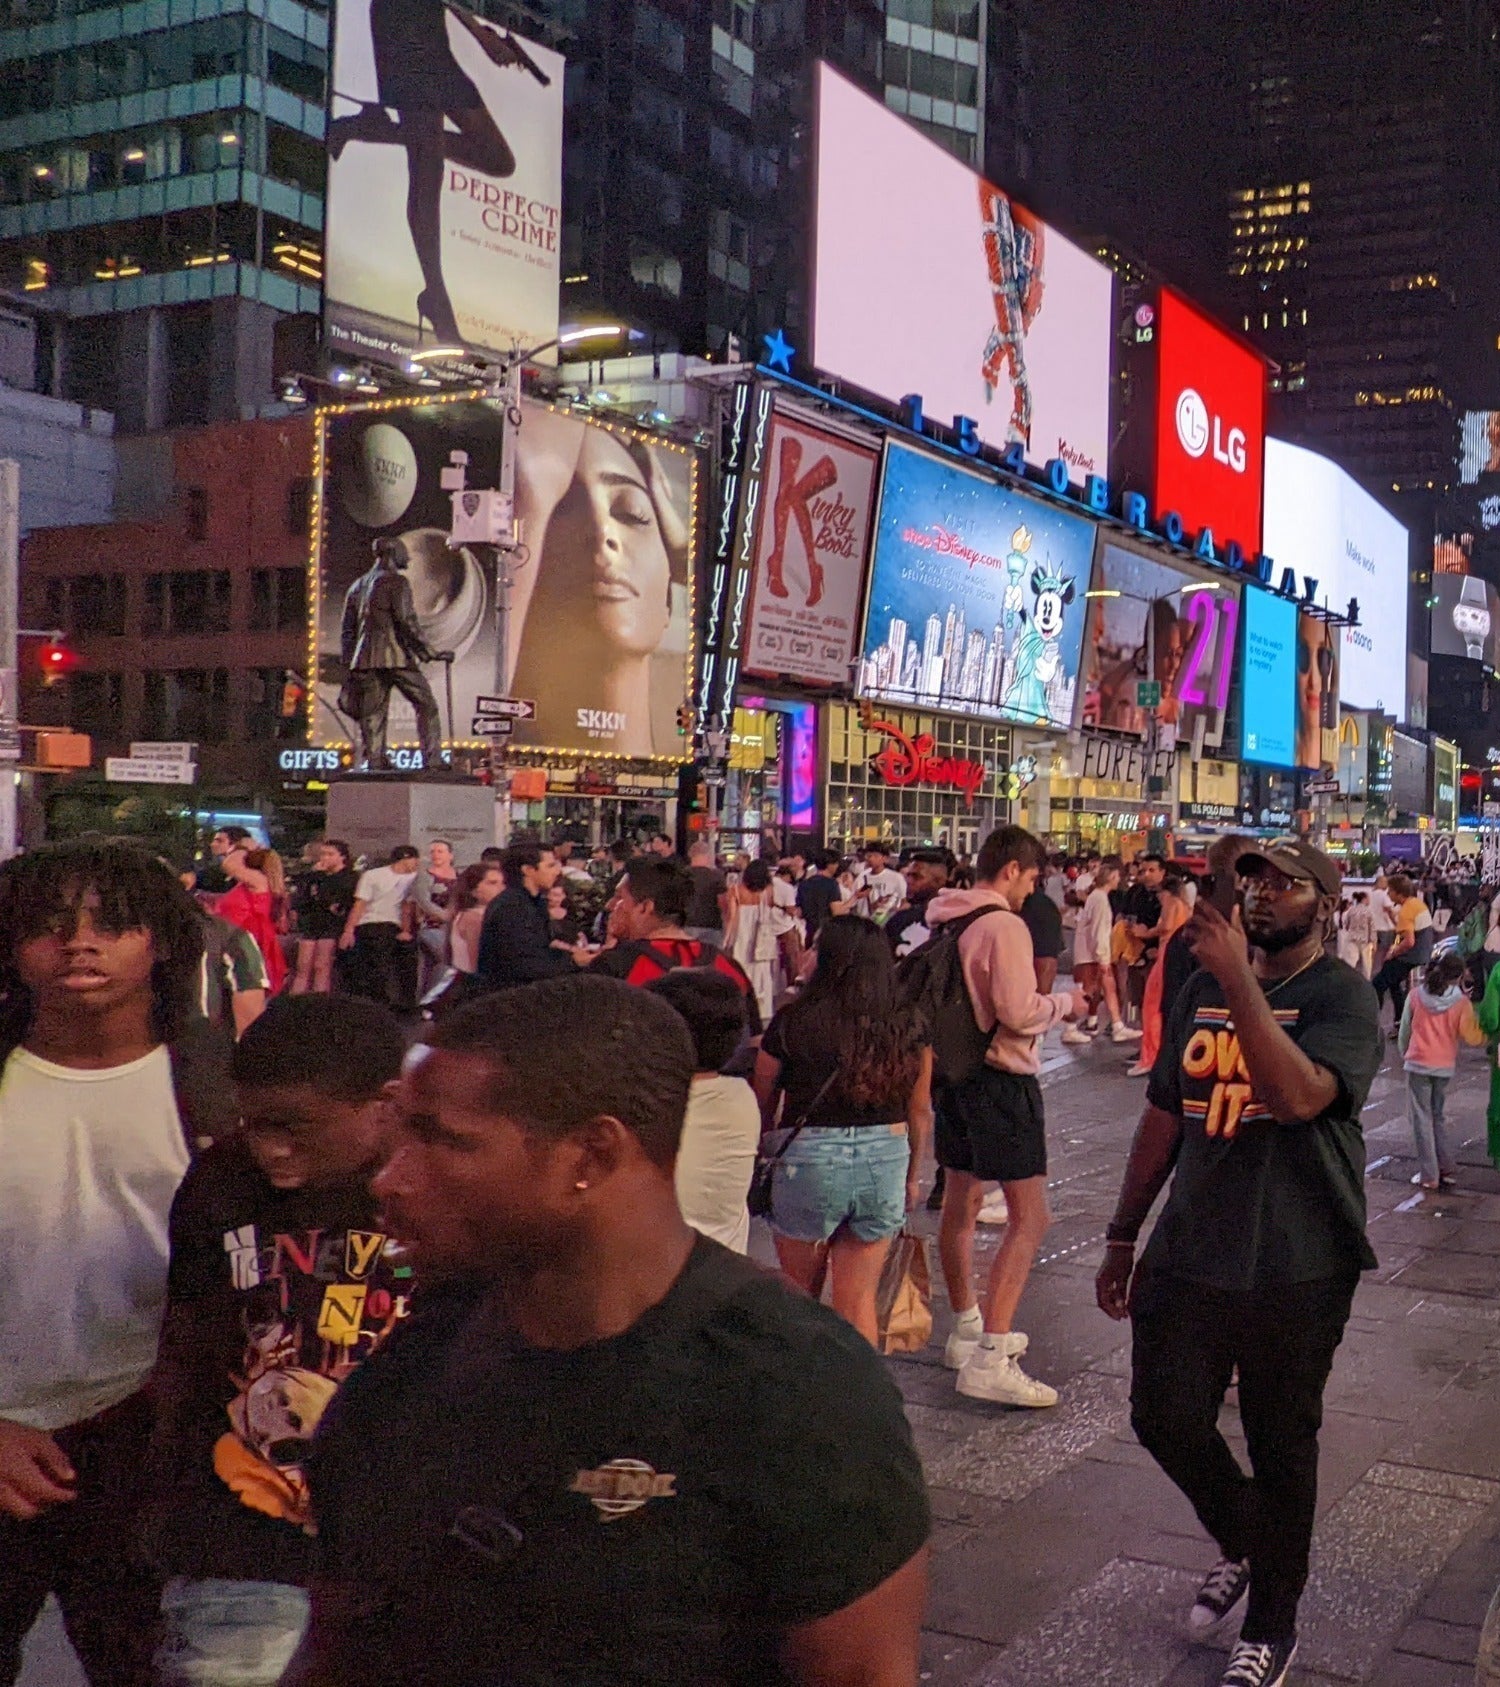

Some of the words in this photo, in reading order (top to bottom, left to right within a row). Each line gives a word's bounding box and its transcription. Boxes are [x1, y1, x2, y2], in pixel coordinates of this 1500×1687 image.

[449, 170, 559, 229] PERFECT
[481, 207, 557, 253] CRIME
[330, 324, 350, 341] The
[351, 330, 390, 351] Theater
[1135, 327, 1153, 343] LG
[1213, 414, 1247, 474] LG
[900, 393, 1069, 494] 1540
[1085, 473, 1320, 601] BROADWAY
[1178, 589, 1238, 710] 21
[577, 708, 627, 730] SKKN
[279, 750, 340, 770] GIFTS
[869, 721, 985, 808] Disney
[1202, 805, 1219, 816] POLO
[1206, 1082, 1252, 1139] IT
